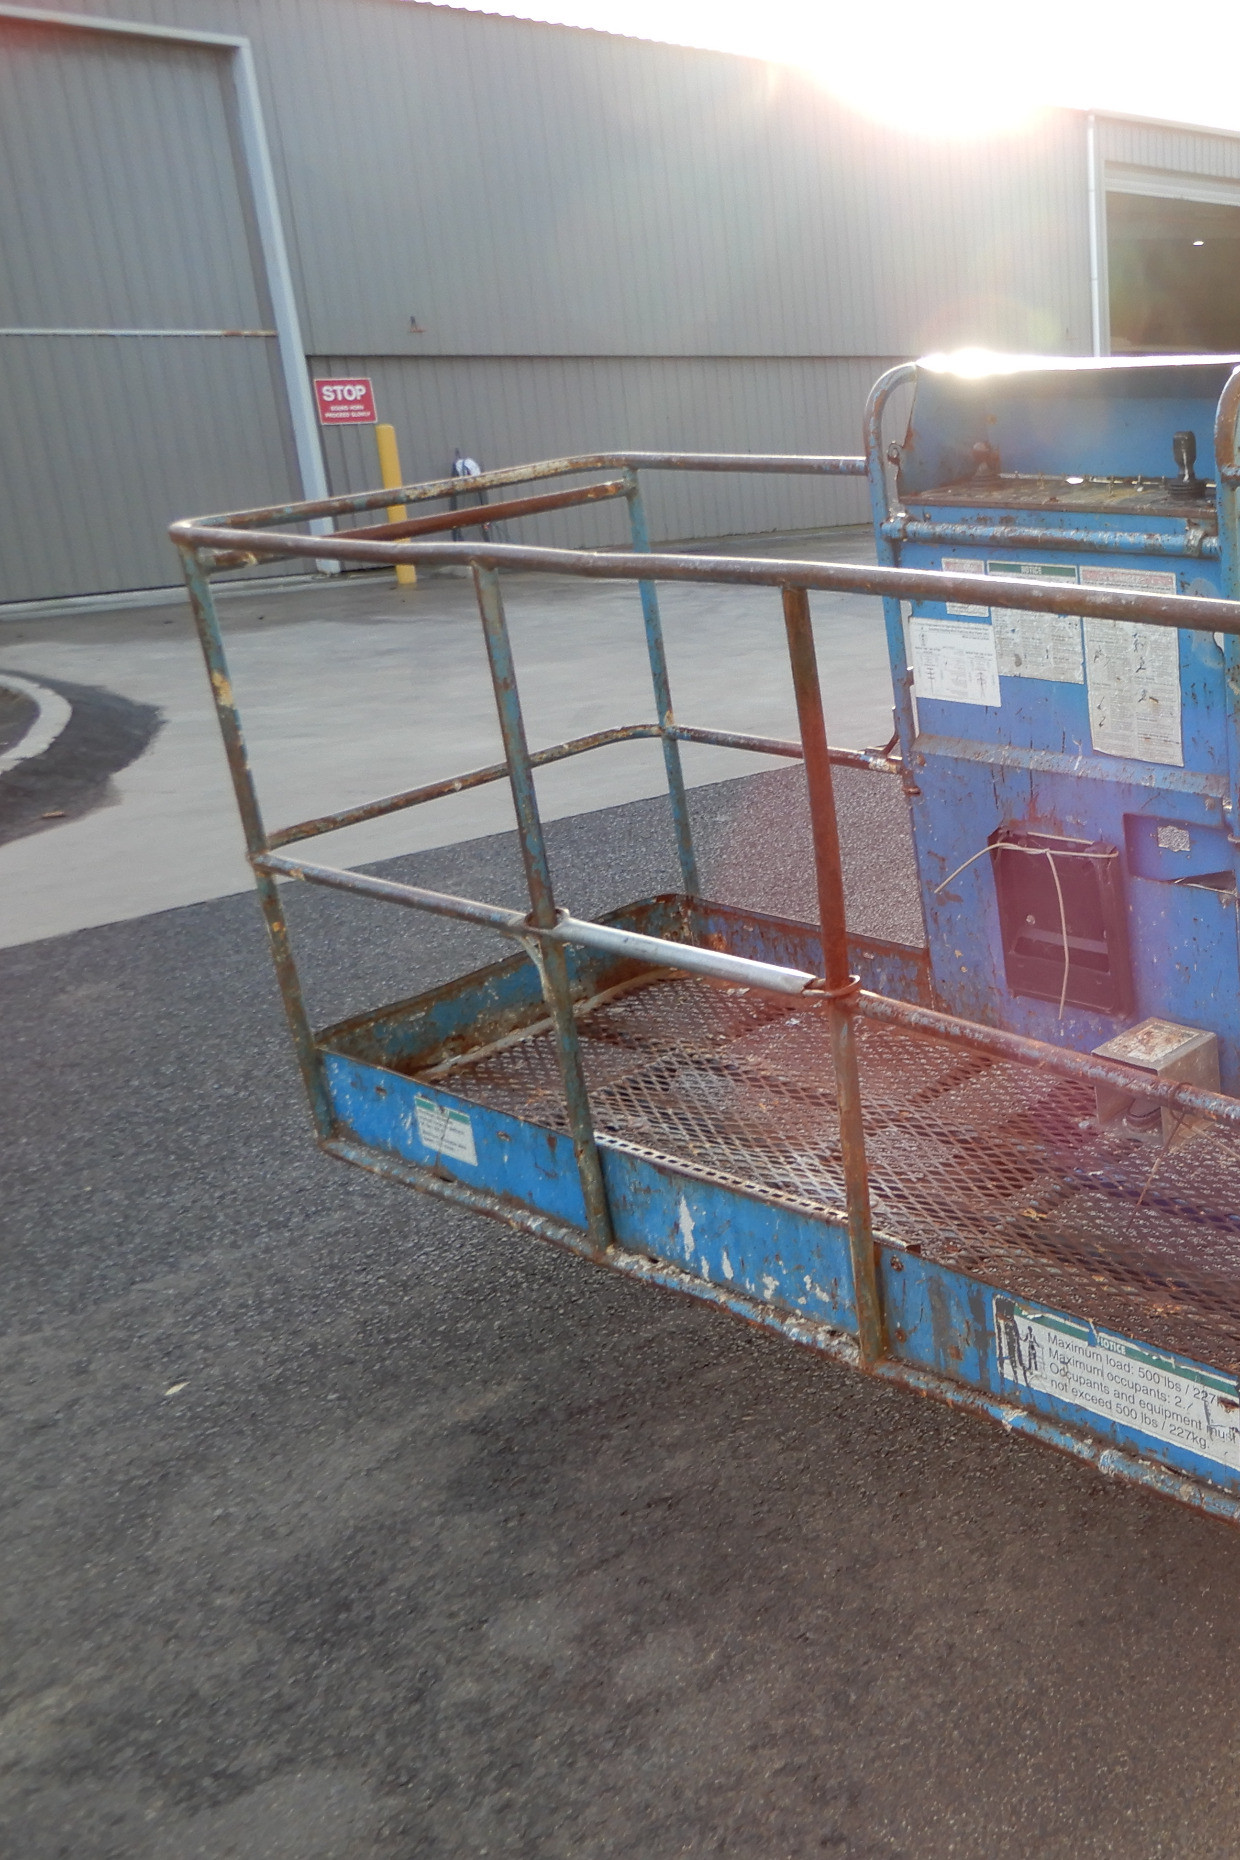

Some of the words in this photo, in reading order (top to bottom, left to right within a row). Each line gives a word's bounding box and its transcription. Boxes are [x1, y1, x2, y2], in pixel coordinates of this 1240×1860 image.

[321, 385, 366, 401] STOP
[1020, 565, 1041, 575] NOTICE
[1047, 1332, 1103, 1362] Maximum
[1106, 1354, 1134, 1375] load:
[1138, 1366, 1160, 1385] 500
[1164, 1375, 1182, 1393] lbs
[1097, 1336, 1126, 1355] NOTICE
[1048, 1347, 1103, 1377] Maximum
[1106, 1372, 1170, 1404] occupants:
[1049, 1362, 1110, 1395] Occupants
[1113, 1389, 1135, 1405] and
[1138, 1399, 1202, 1431] equipment
[1051, 1379, 1068, 1393] not
[1071, 1387, 1112, 1410] exceed
[1115, 1403, 1138, 1420] 500
[1141, 1412, 1158, 1428] lbs
[1169, 1423, 1210, 1450] 227kg.
